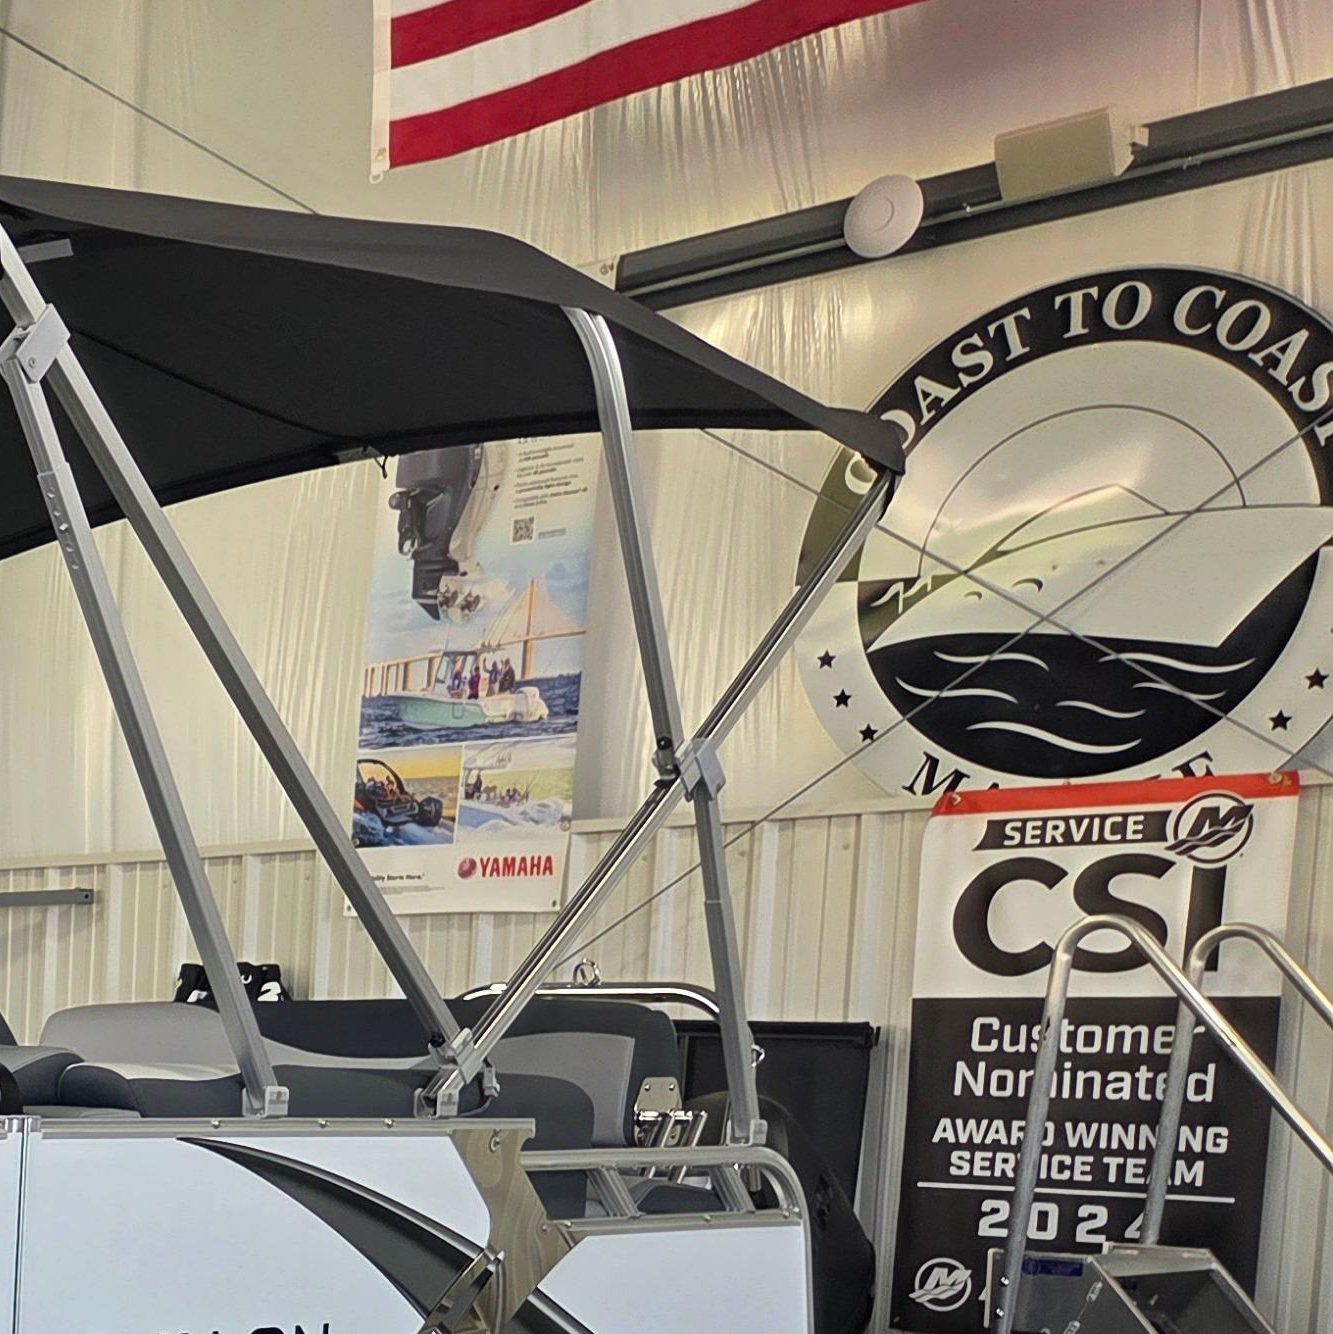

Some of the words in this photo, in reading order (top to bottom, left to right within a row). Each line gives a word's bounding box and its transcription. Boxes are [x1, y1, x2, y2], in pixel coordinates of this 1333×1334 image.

[1054, 281, 1153, 340] TO
[1003, 814, 1145, 847] SERVICE
[480, 855, 554, 878] YAMAHA
[953, 853, 1228, 977] CSI
[1064, 1121, 1230, 1154] WINNNG
[949, 1150, 1094, 1182] SERICE
[1102, 1156, 1205, 1187] TEM
